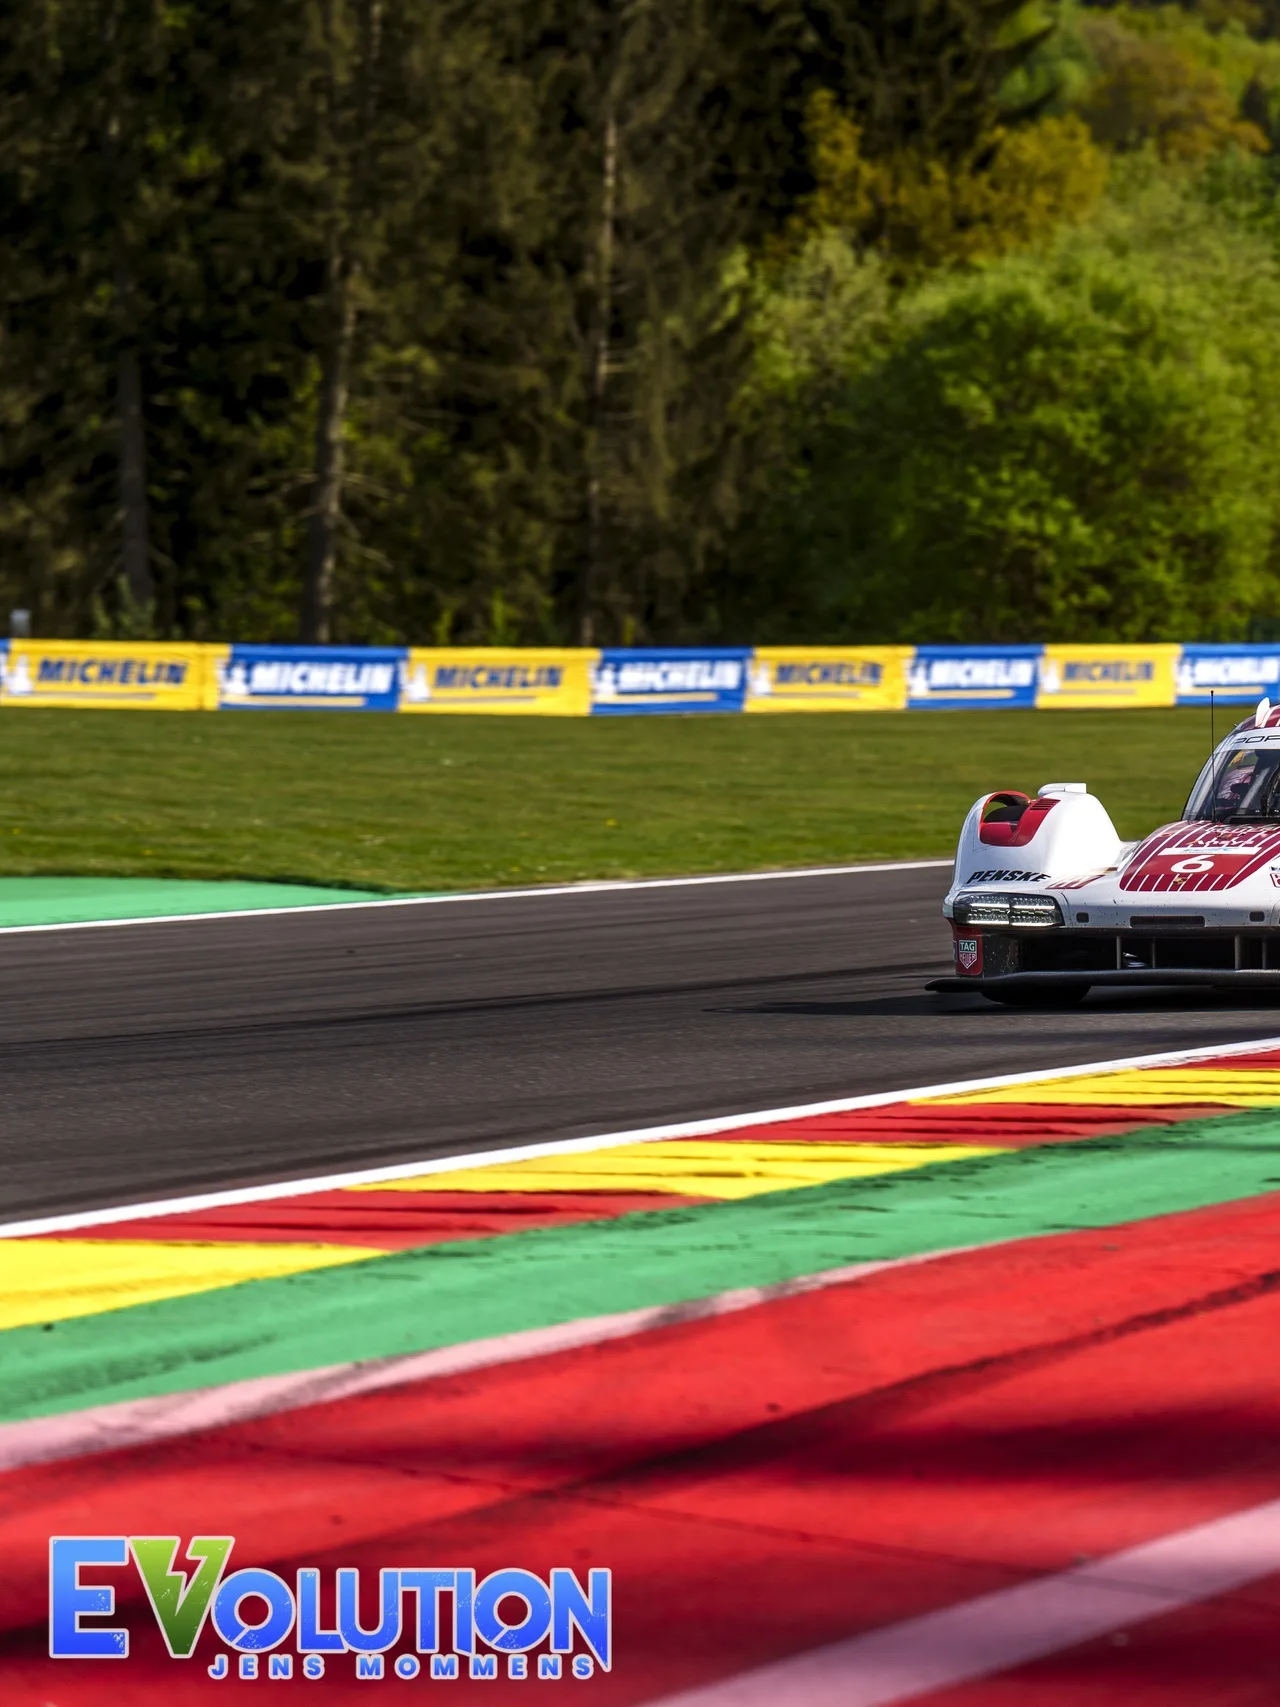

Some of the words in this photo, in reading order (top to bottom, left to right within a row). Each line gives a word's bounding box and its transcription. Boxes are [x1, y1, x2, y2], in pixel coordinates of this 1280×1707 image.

[38, 657, 187, 685] MICHELIN
[251, 661, 394, 694] MICHELIN
[435, 665, 564, 689] MICHELIN
[776, 661, 884, 687] MICHELIN
[930, 659, 1035, 687] MICHELIN
[1064, 661, 1154, 682] MICHELIN
[1170, 854, 1215, 873] 6
[966, 869, 1052, 884] PENSKE
[959, 942, 975, 951] TAG
